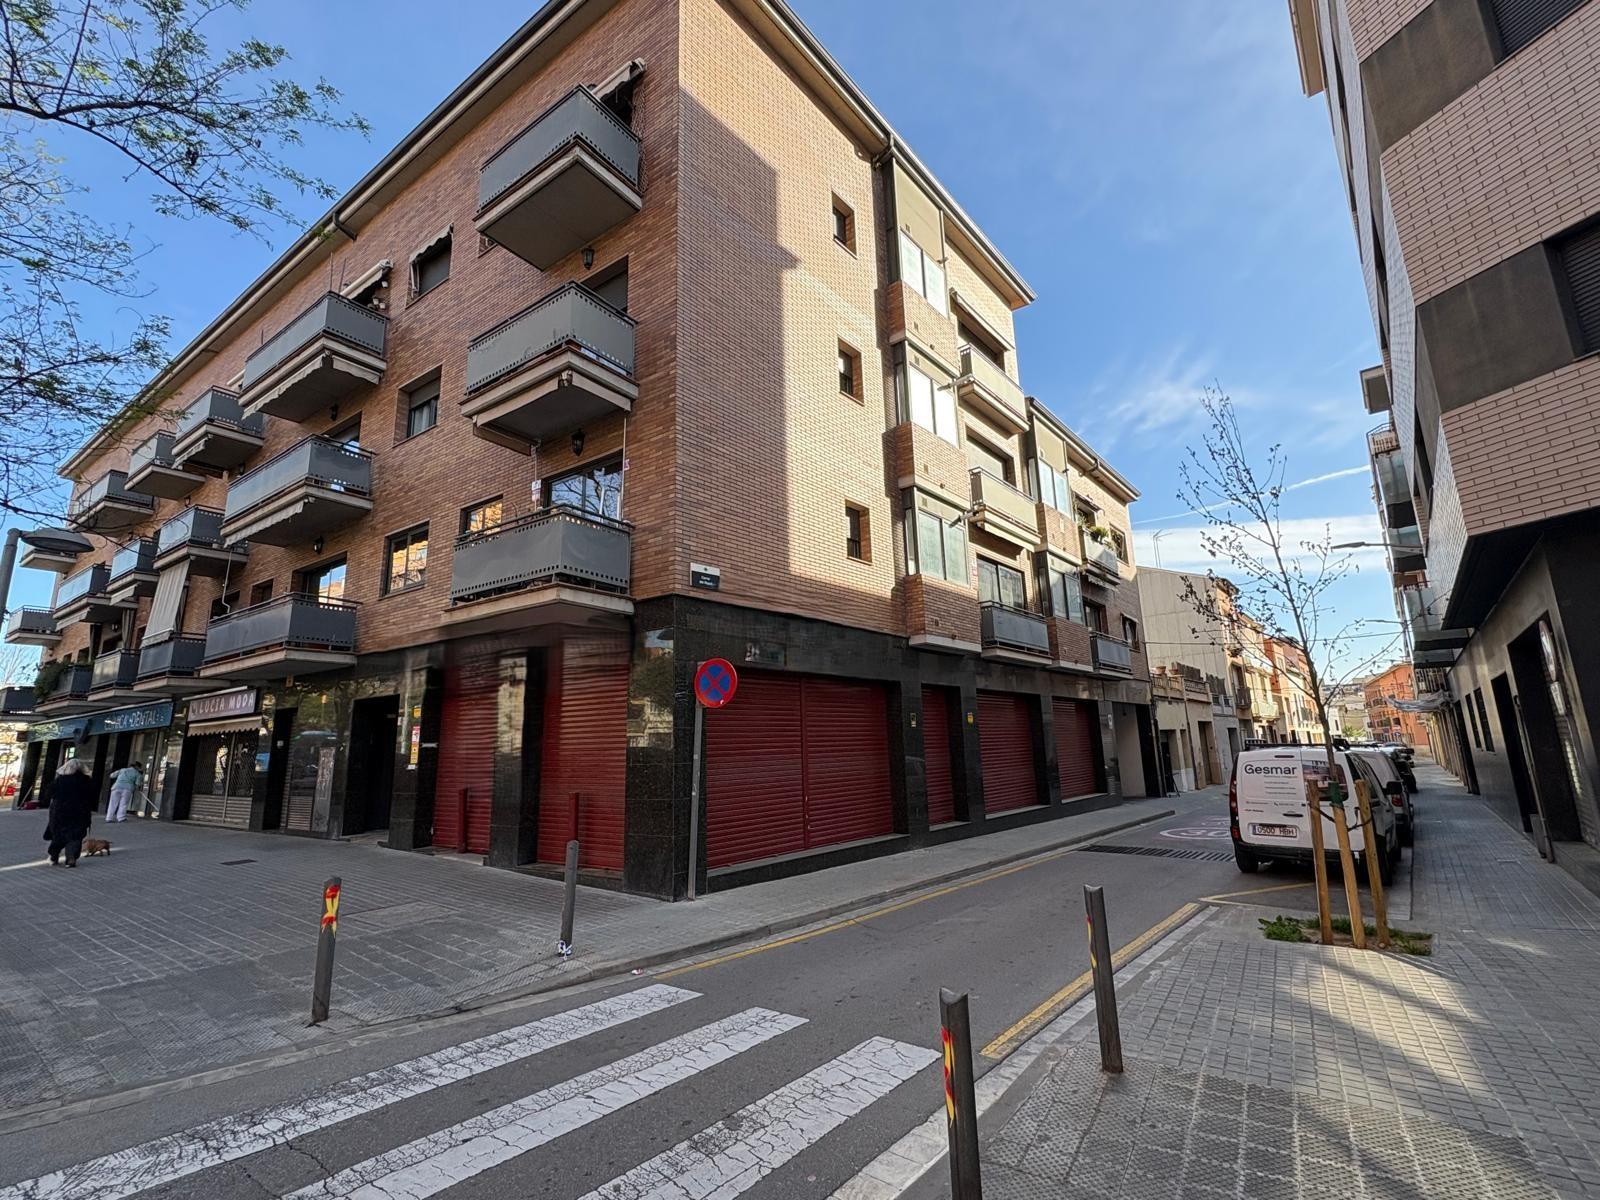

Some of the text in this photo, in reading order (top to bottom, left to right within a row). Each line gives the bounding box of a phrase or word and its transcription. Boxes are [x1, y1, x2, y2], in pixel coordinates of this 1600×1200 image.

[200, 692, 254, 714] LUCIA MODA
[1244, 764, 1297, 775] Gesmar
